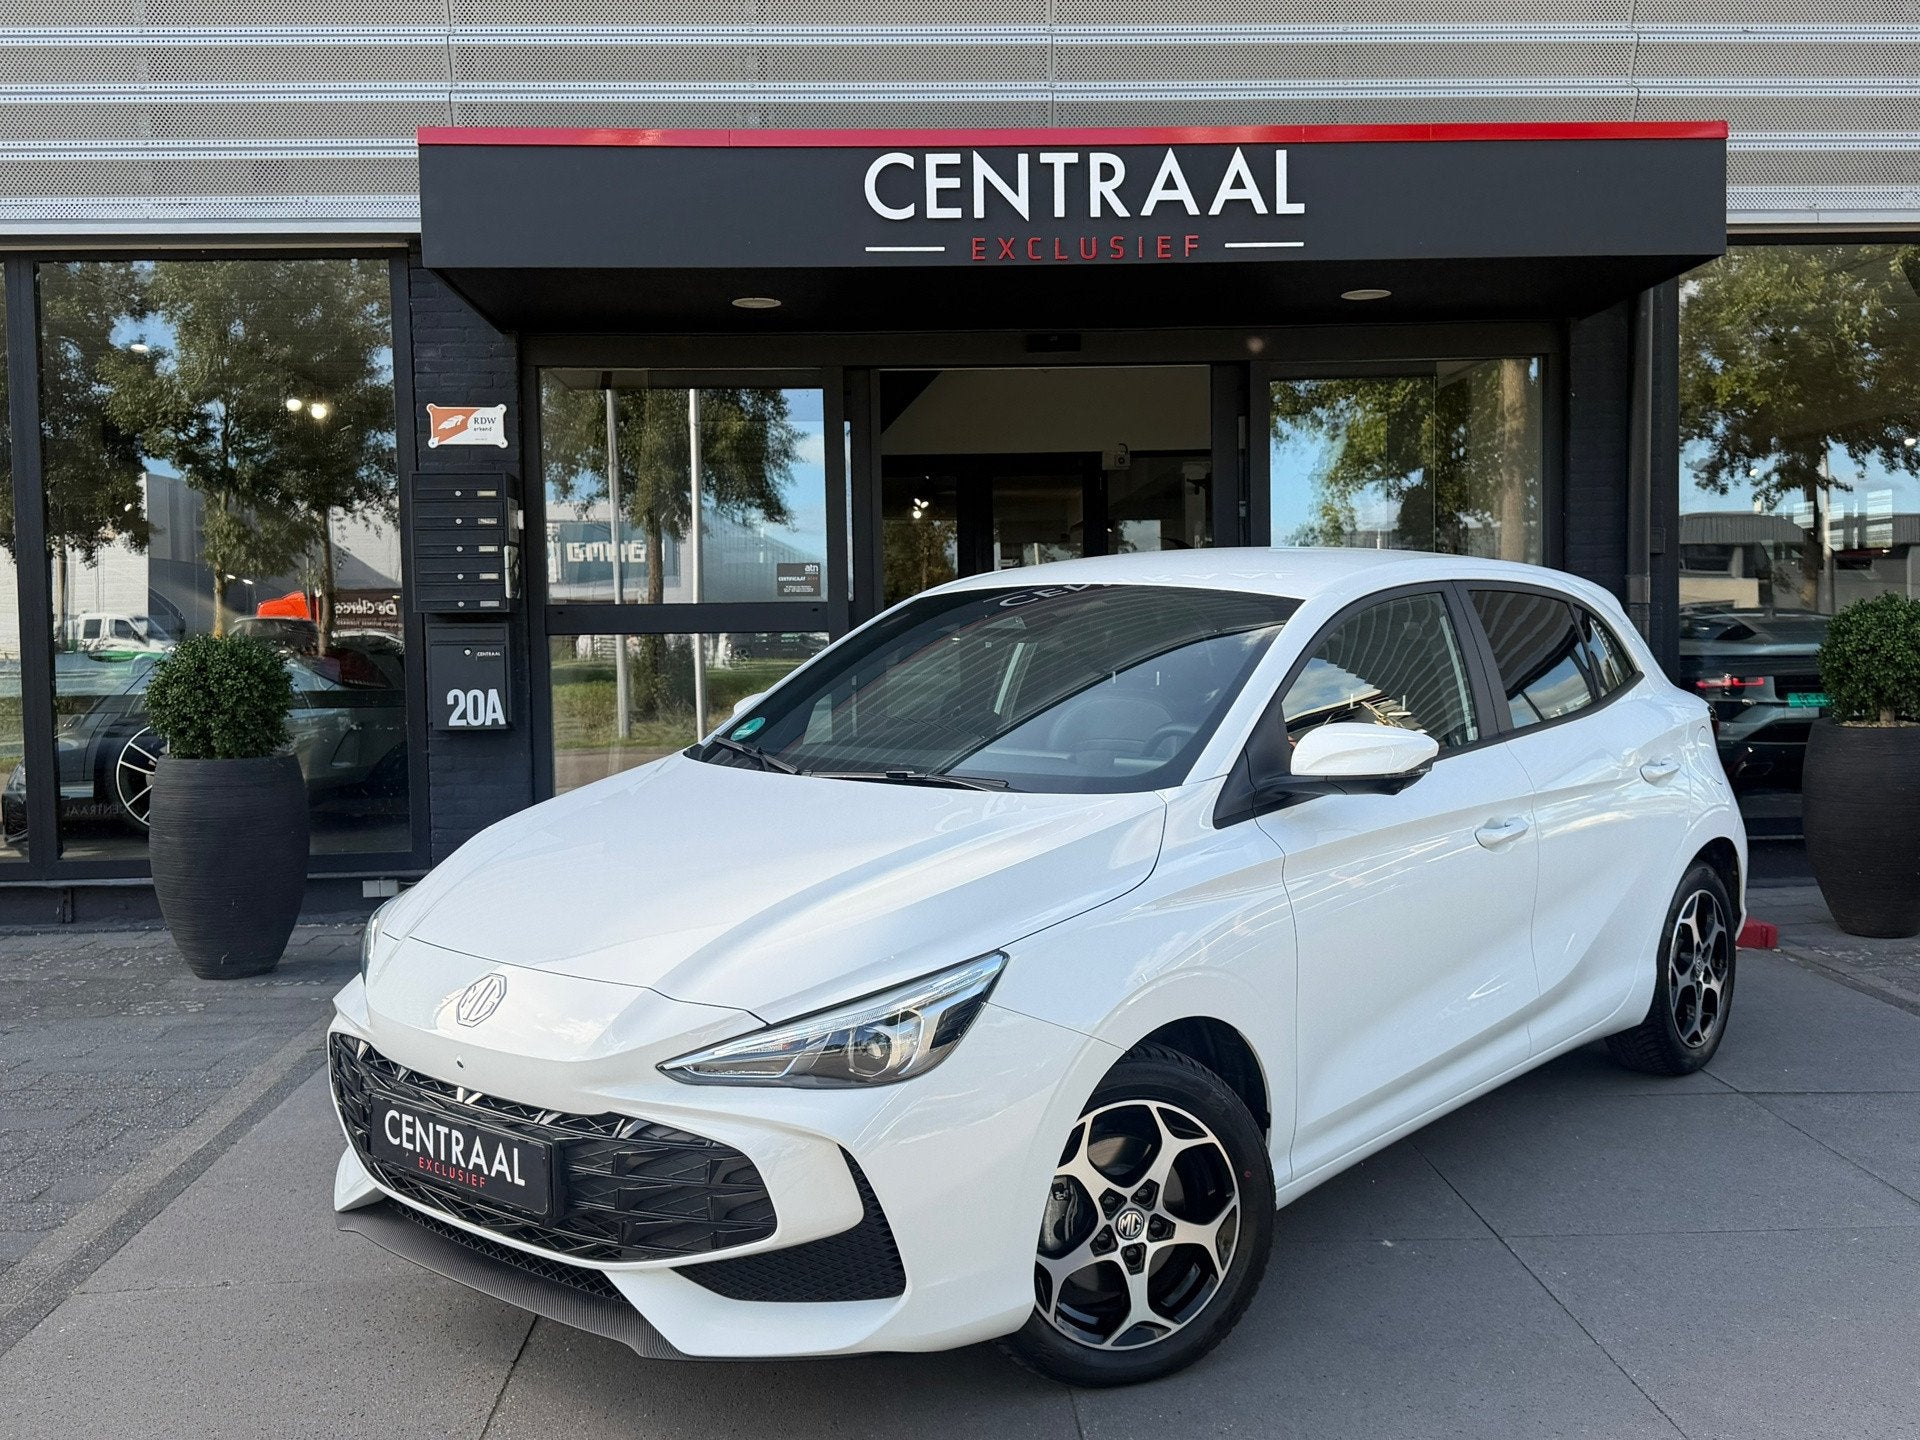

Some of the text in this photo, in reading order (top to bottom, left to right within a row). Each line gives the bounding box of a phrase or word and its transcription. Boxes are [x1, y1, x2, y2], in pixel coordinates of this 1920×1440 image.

[864, 146, 1306, 222] CENTRAAL
[971, 234, 1200, 261] EXCLUSIEF
[473, 416, 497, 425] RDW
[446, 688, 506, 727] 20A
[458, 976, 504, 1025] MG
[384, 1109, 526, 1187] CENTRAAL
[418, 1156, 487, 1188] EXCLUSIEF
[1120, 1212, 1142, 1237] MG
